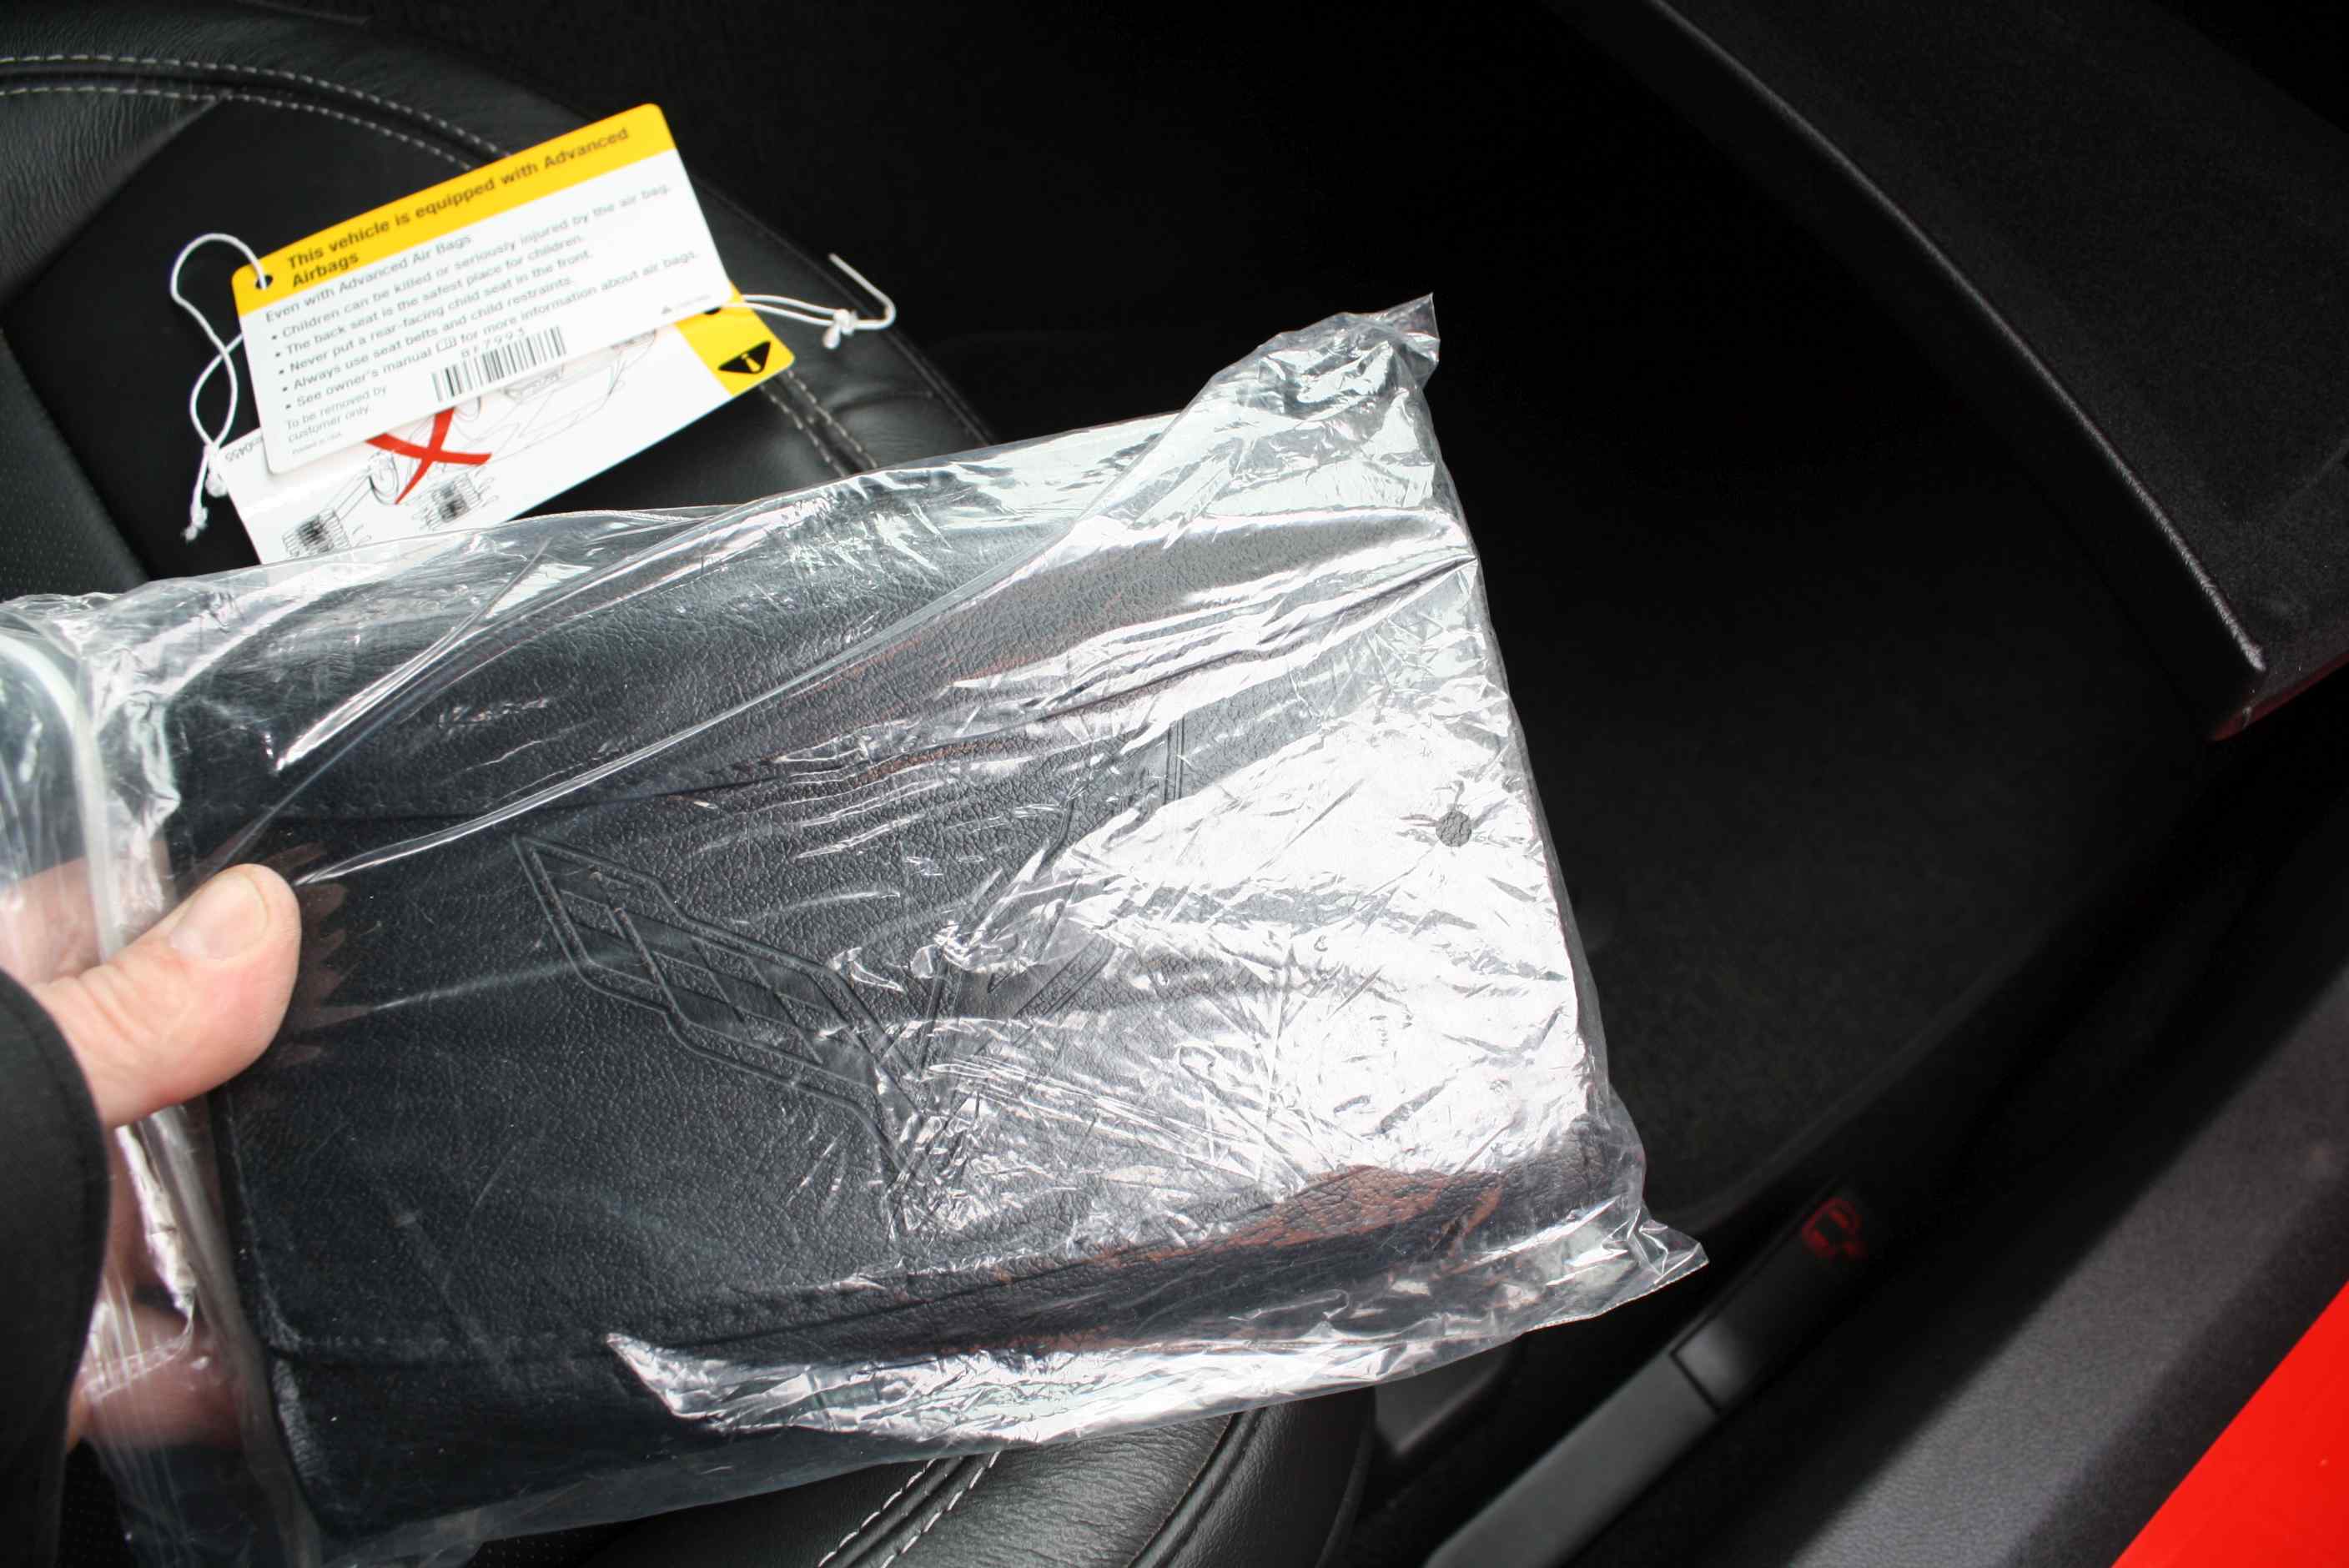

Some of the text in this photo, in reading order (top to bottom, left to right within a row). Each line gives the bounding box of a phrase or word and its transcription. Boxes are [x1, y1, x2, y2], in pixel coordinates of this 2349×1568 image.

[289, 128, 629, 269] This vehicle is equipped with Advanced
[265, 234, 471, 323] Even with Advanced Air Bags
[282, 184, 672, 338] Children can be killed or seriously injured by the air bag.
[286, 235, 584, 354] The back seat is the safest place for children.
[290, 352, 326, 372] Never
[333, 340, 354, 358] put
[370, 306, 445, 340] rear-facing
[448, 290, 480, 310] child
[483, 279, 512, 296] seat
[515, 274, 529, 284] in
[531, 264, 552, 277] the
[556, 249, 591, 269] front.
[293, 254, 359, 287] Airbags
[294, 277, 574, 389] Always use seat belts and child restraints.
[297, 250, 699, 407] See owner's manual for more information about air bags.
[287, 386, 387, 430] To be removed by
[288, 405, 371, 443] customer only.
